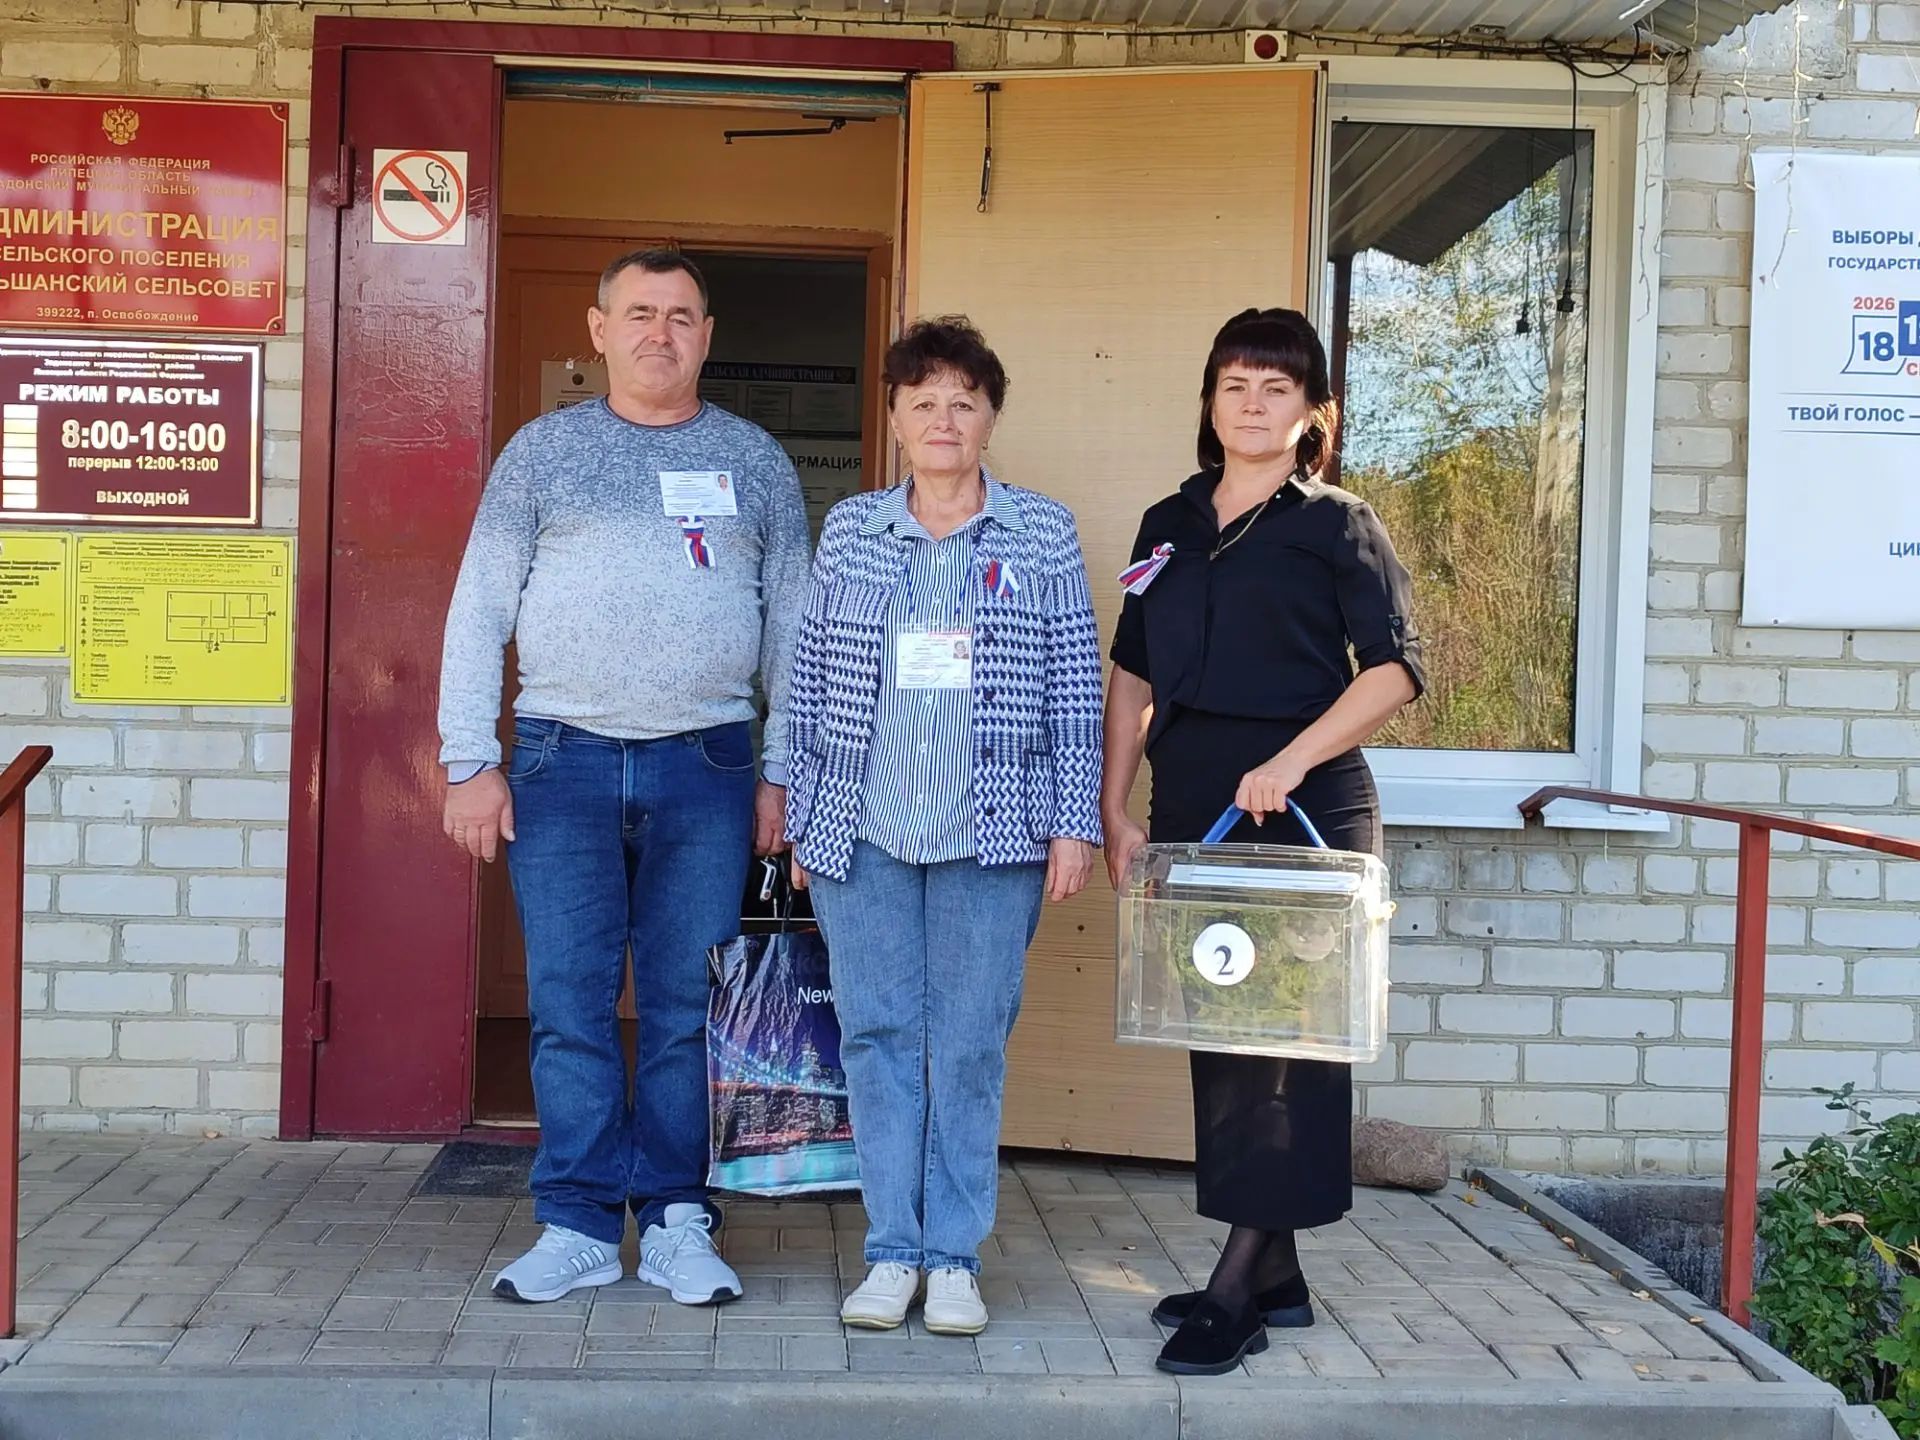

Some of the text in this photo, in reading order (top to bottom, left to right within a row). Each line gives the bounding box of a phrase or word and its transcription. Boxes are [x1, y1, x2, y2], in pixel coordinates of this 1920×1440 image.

[30, 153, 210, 171] РОССИЙСКАЯ ФЕДЕРАЦИЯ
[128, 170, 191, 182] ОБЛАСТЬ
[1832, 230, 1913, 245] ВЫБОРЫ
[0, 245, 250, 269] ЕЛЬСКОГО ПОСЕЛЕНИЯ
[134, 276, 276, 298] СЕЛЬСОВЕТ
[37, 307, 84, 319] 399222,
[88, 310, 99, 319] п.
[1853, 297, 1895, 310] 2026
[1903, 314, 1920, 345] 1
[1858, 331, 1894, 361] 18
[1906, 362, 1920, 376] С
[19, 383, 220, 406] РЕЖИМ РАБОТЫ
[1787, 403, 1839, 421] ТВОЙ
[1844, 407, 1904, 422] ГОЛОС
[61, 419, 226, 452] 8:00-16:00
[68, 456, 219, 472] перерыв 12:00-13:00
[1214, 945, 1234, 976] 2
[797, 986, 834, 1005] New
